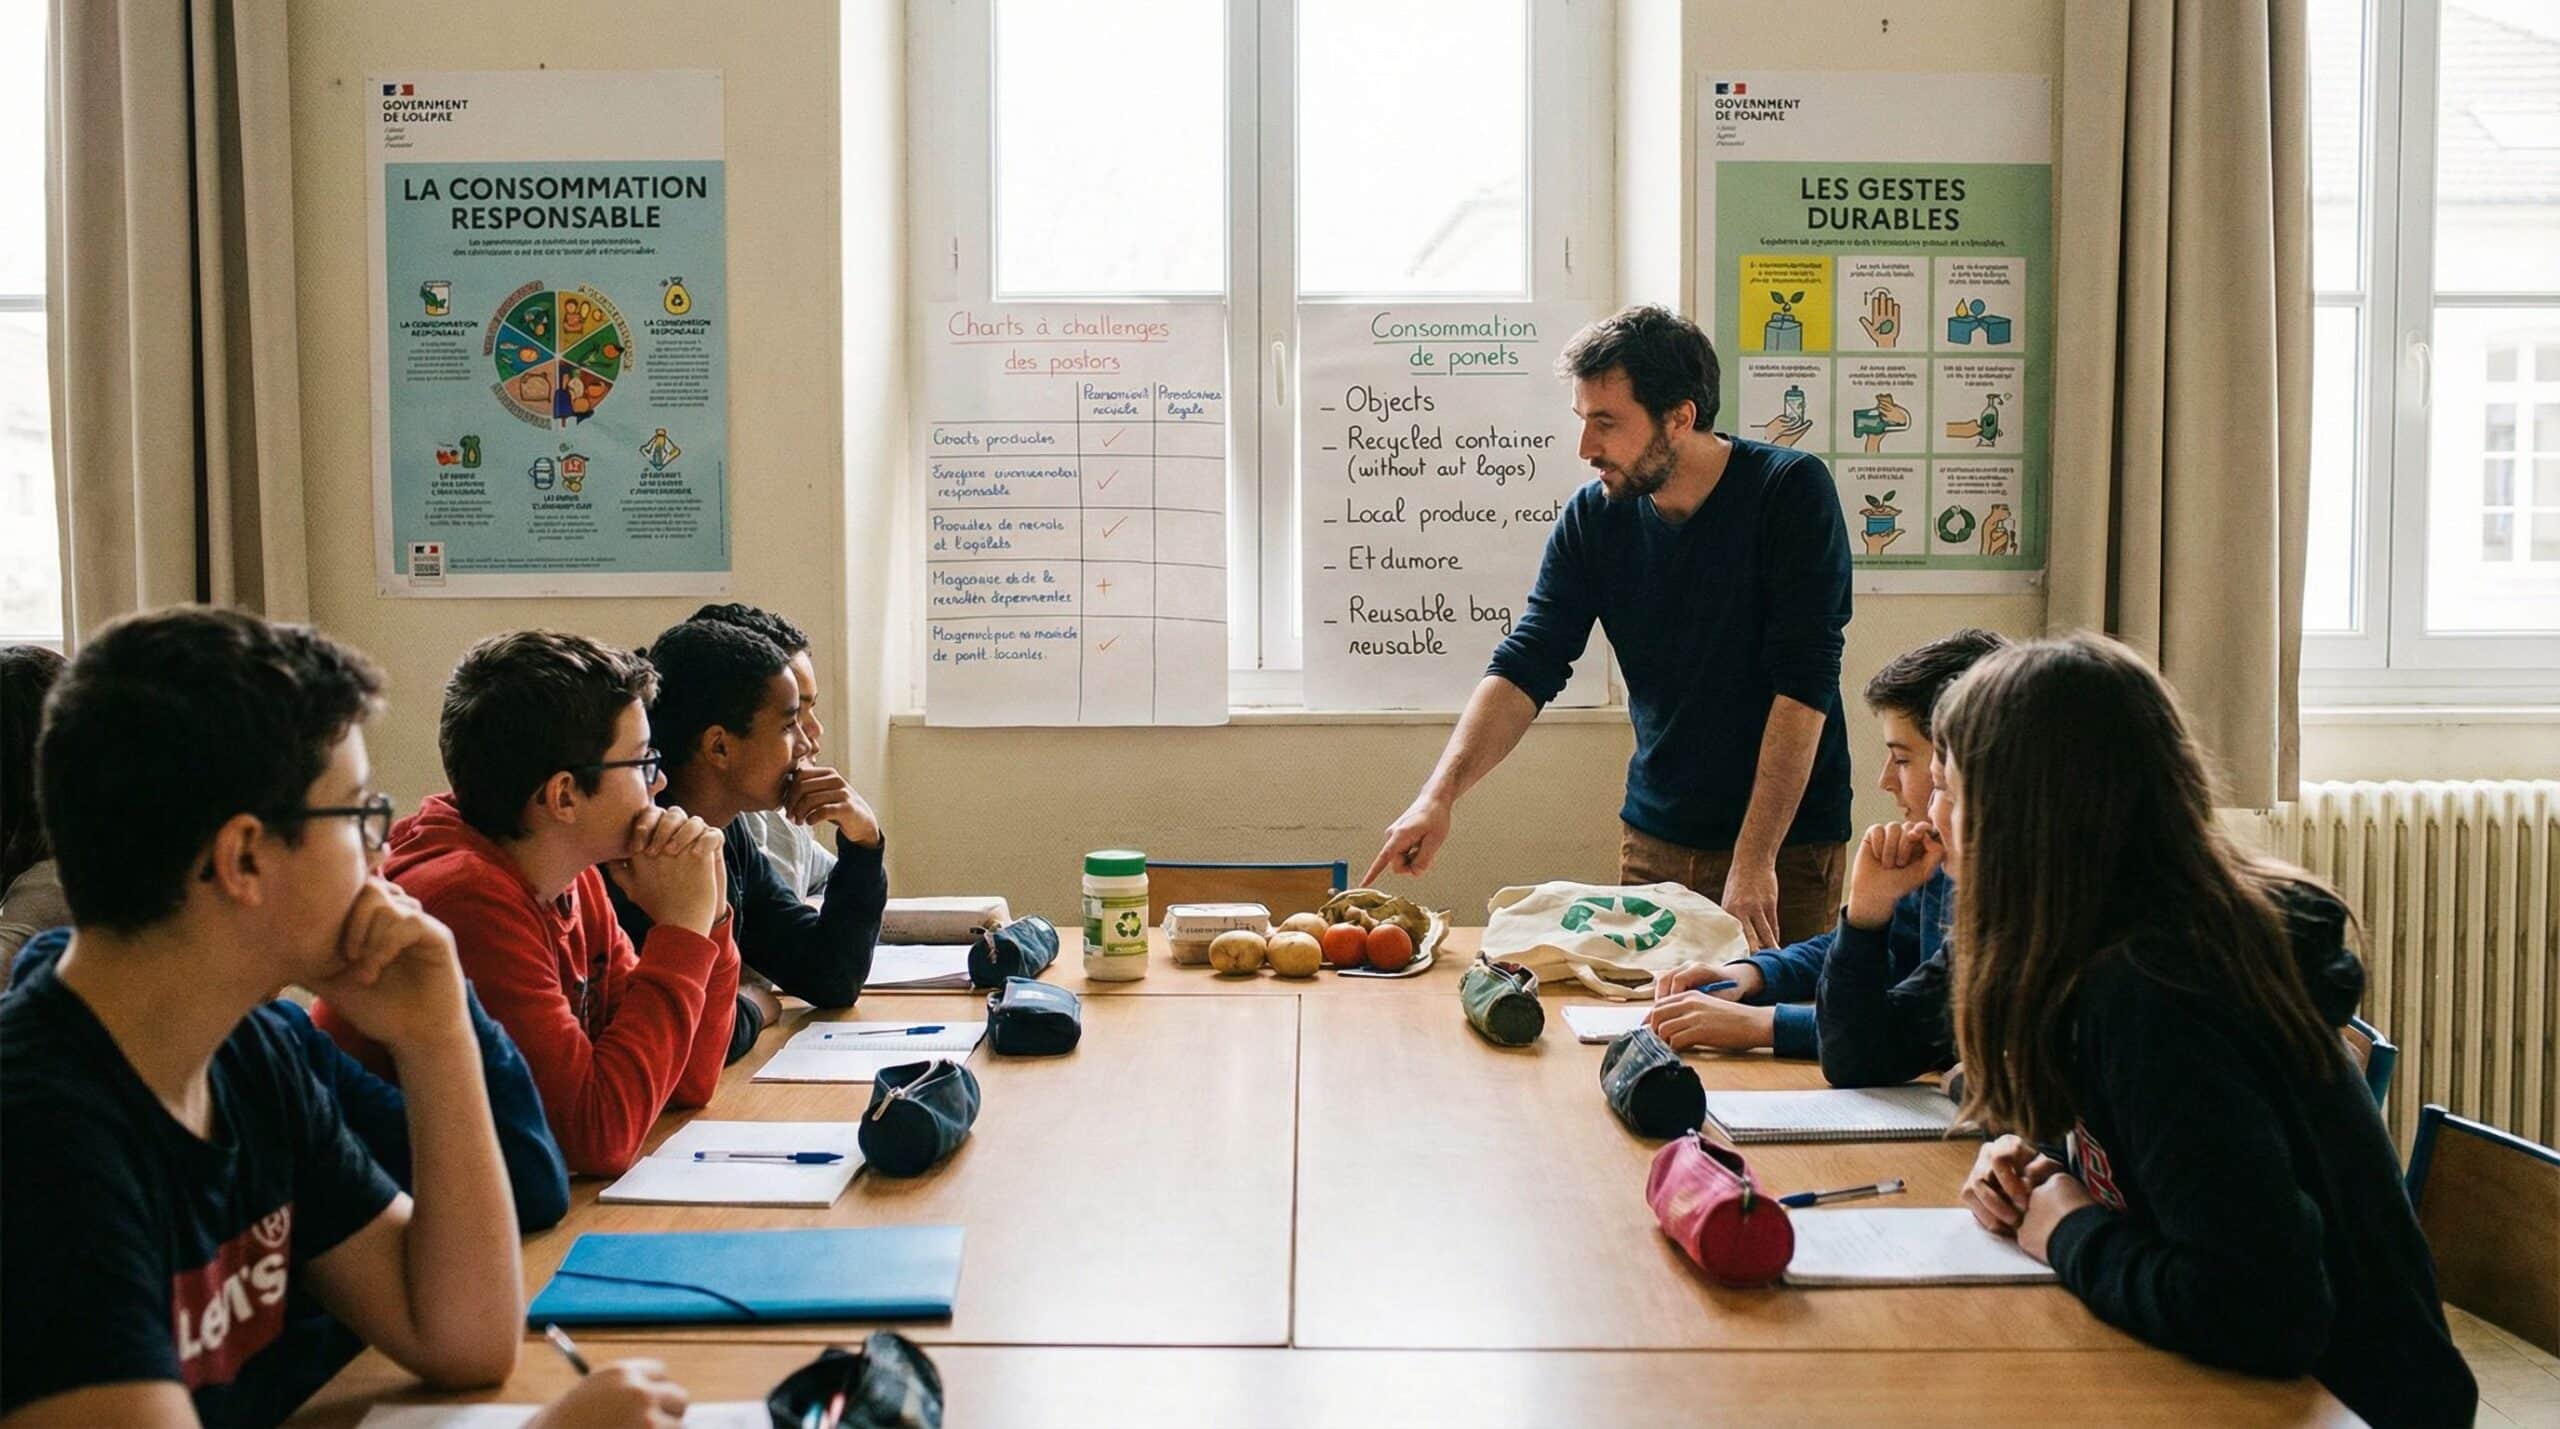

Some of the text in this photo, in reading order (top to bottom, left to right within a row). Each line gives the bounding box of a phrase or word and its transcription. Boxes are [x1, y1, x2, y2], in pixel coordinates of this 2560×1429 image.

[1715, 110, 1731, 121] DE
[404, 175, 707, 201] LA CONSOMMATION
[1801, 177, 1966, 202] LES GESTES
[451, 206, 661, 230] RESPONSABLE
[1807, 207, 1960, 231] DURABLES
[948, 311, 1169, 342] Charts à challenges
[1370, 312, 1537, 338] Consommation
[1004, 349, 1038, 370] des
[1410, 345, 1434, 366] de
[1346, 385, 1435, 422] Objects
[1348, 425, 1555, 458] Recycled container
[1347, 455, 1427, 483] (without
[1477, 454, 1536, 486] logos)
[1347, 497, 1406, 523] Local
[1420, 500, 1508, 532] produce,
[1349, 593, 1511, 636] Reusable bag
[1349, 627, 1448, 656] reusable
